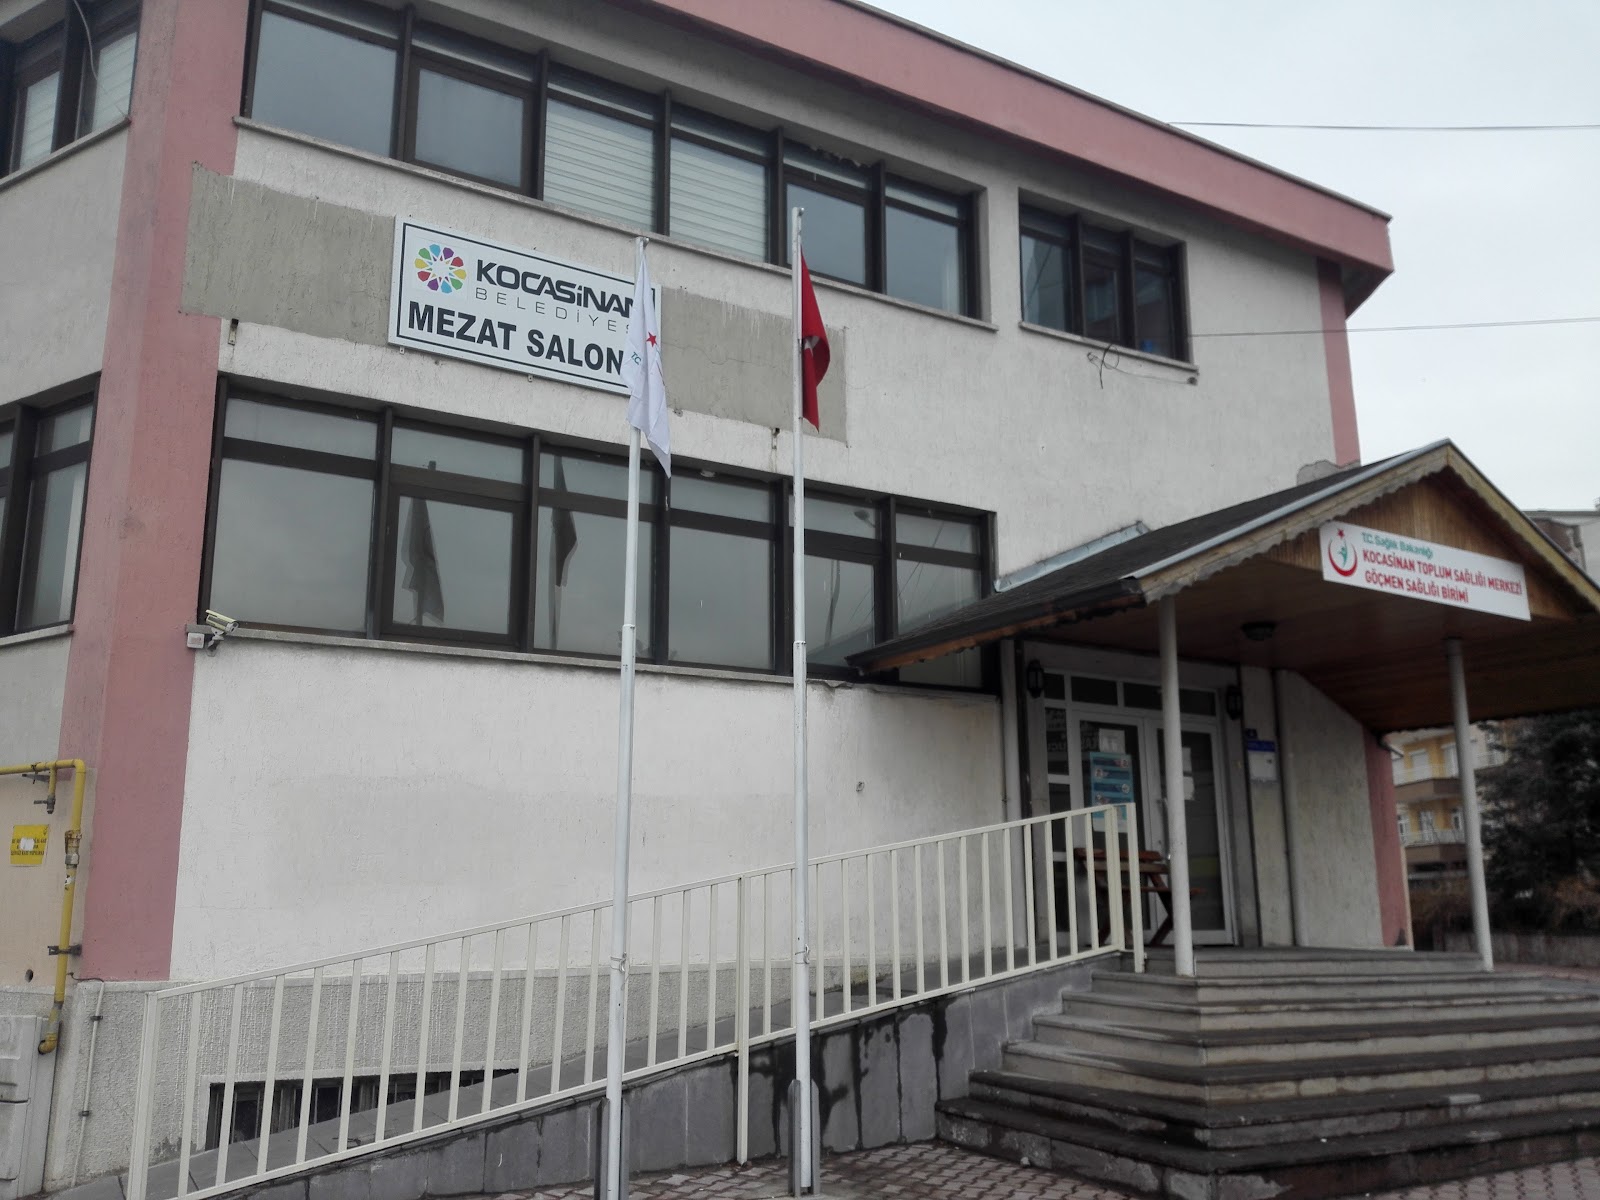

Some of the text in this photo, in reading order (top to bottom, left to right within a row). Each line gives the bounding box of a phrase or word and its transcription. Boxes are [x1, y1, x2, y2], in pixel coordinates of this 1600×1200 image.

[408, 300, 624, 376] MEZAT SALON
[1362, 549, 1523, 595] KOCASİNAN TOPLUM SAĞLIĞI MERKEZİ
[1365, 569, 1470, 603] GÖÇMEN SAĞLIĞI BİRİMİ
